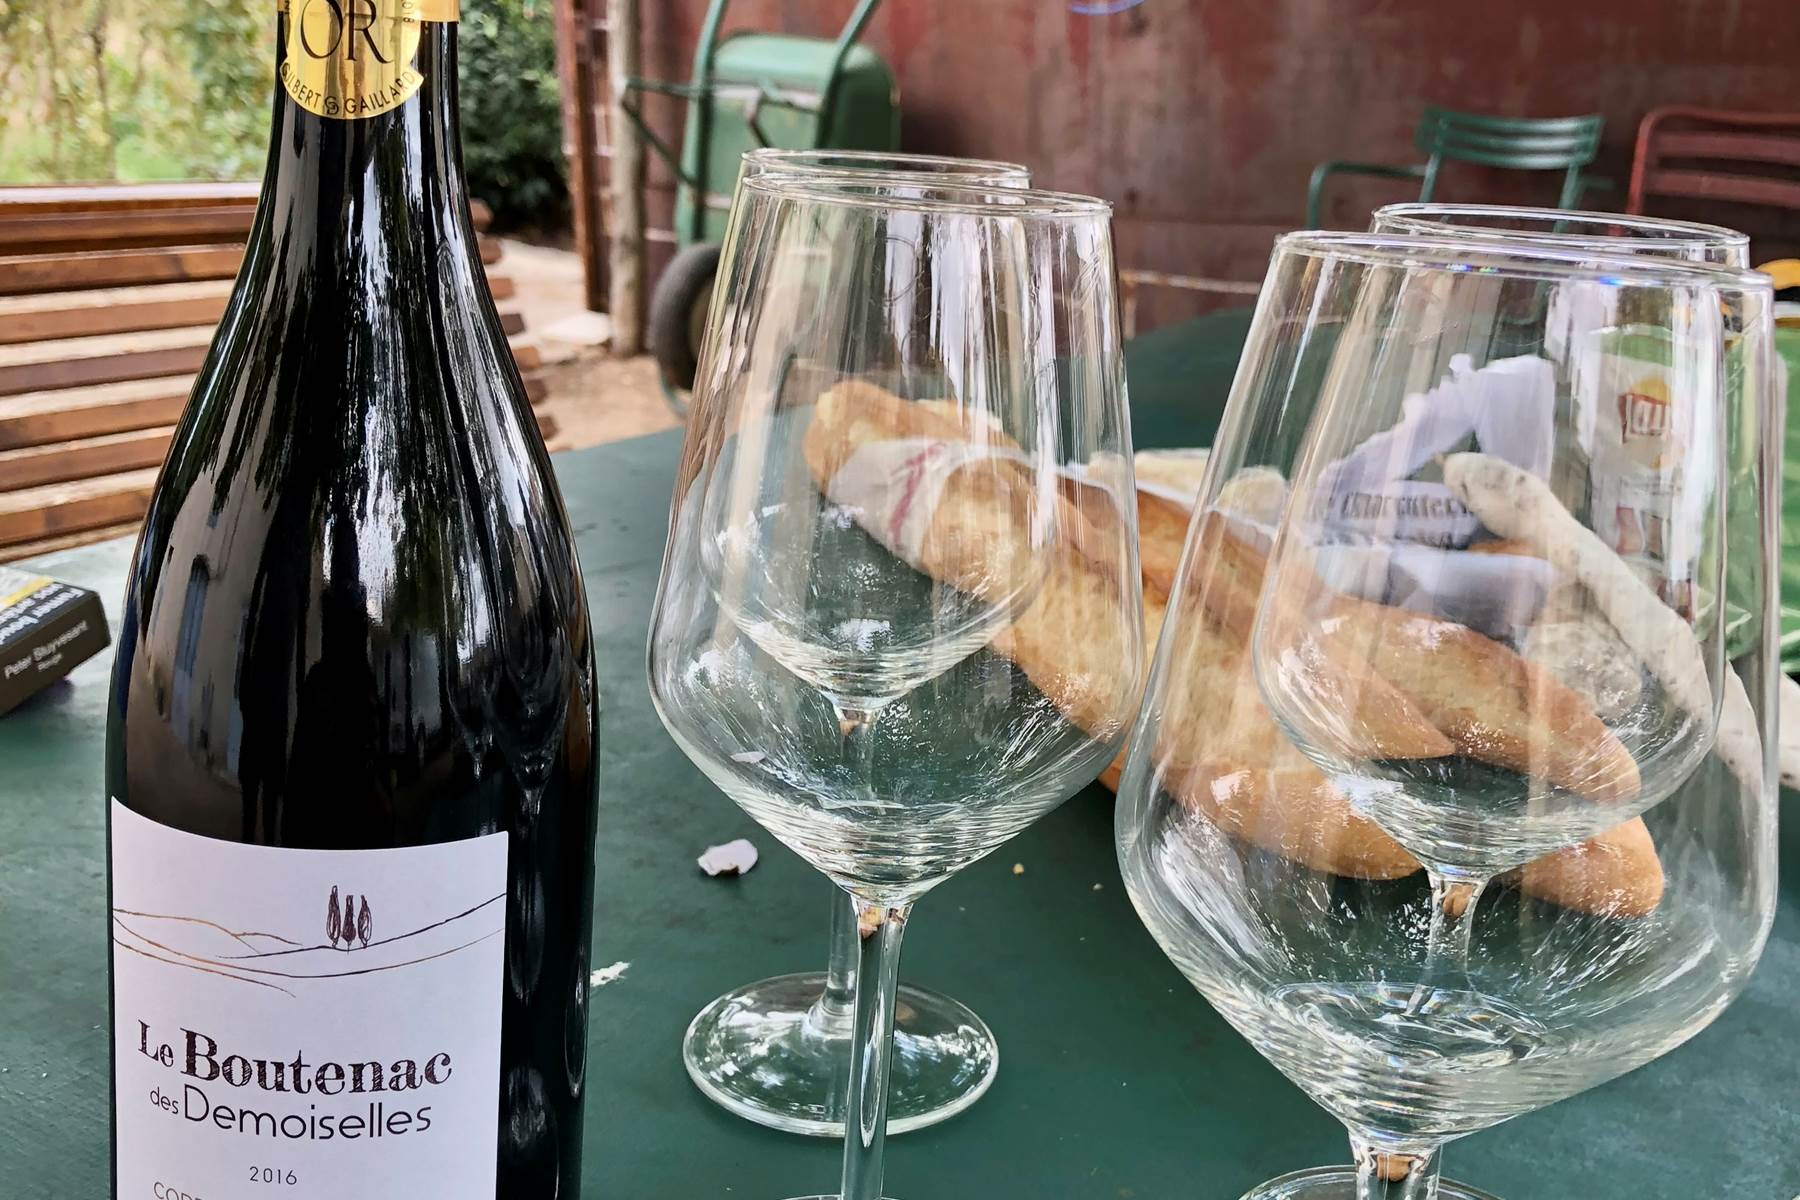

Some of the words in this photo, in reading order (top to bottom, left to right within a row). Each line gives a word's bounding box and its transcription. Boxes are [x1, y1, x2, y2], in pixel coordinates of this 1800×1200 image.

[300, 0, 394, 64] OR
[281, 62, 322, 110] GILBERT
[344, 70, 416, 115] GAILLARD
[4, 655, 33, 680] Peter
[137, 1019, 174, 1069] Le
[180, 1027, 453, 1096] Boutenac
[149, 1087, 179, 1115] des
[184, 1084, 432, 1141] Demoiselles
[248, 1165, 298, 1186] 2016
